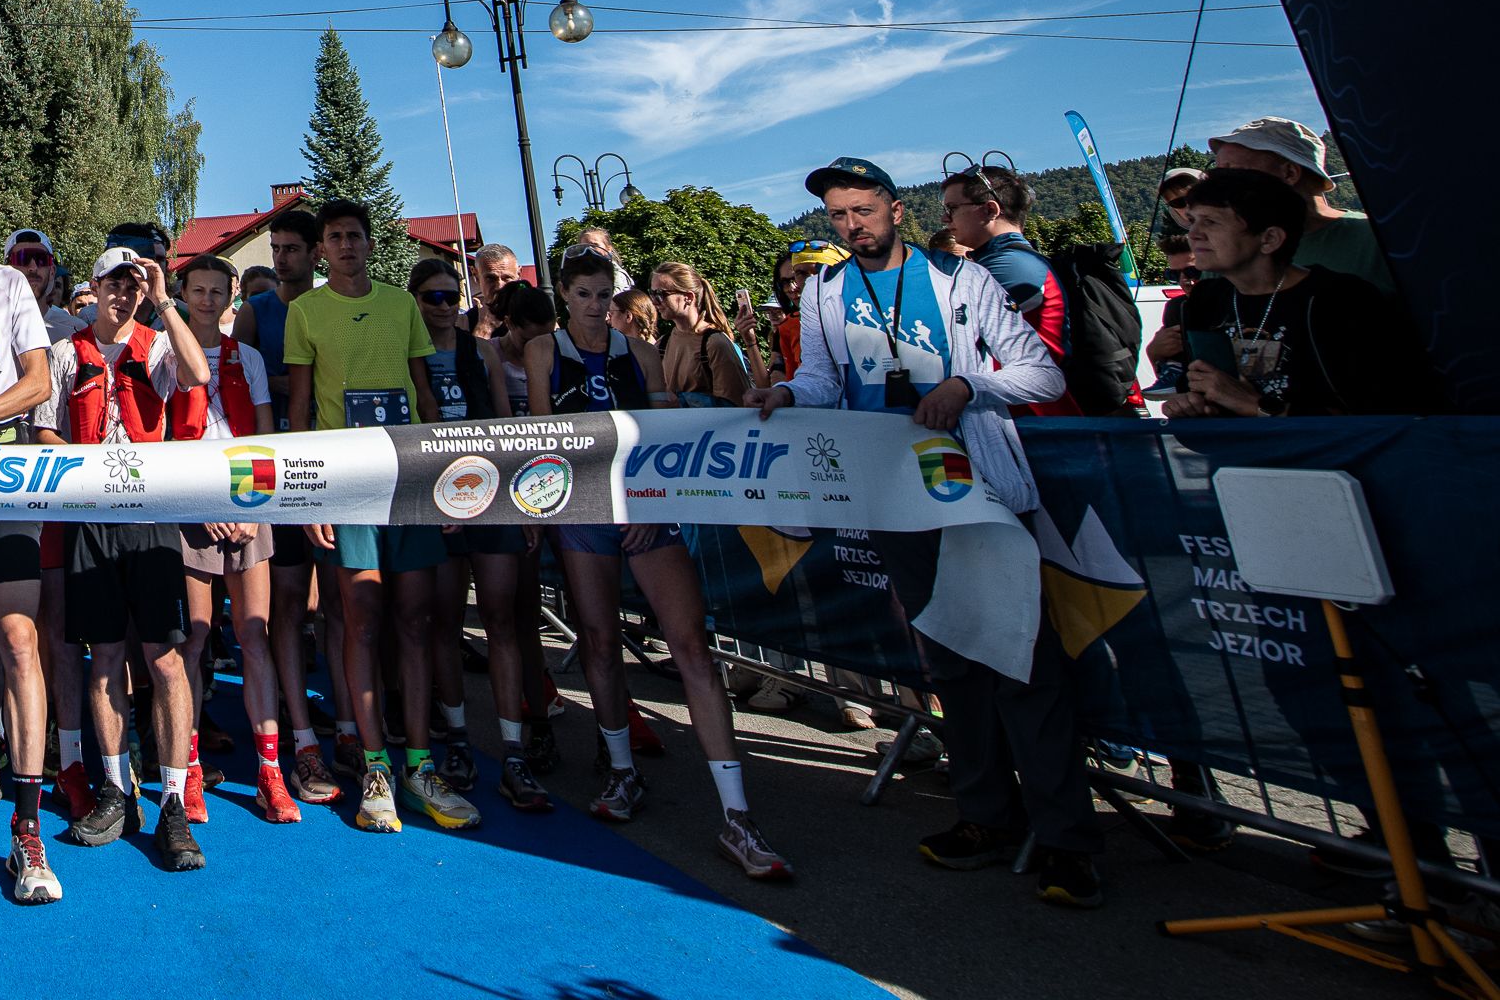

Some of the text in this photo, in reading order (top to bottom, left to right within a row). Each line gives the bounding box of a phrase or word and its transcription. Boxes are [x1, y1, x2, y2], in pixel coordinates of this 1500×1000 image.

[441, 385, 462, 400] 10
[375, 406, 386, 422] 9
[432, 421, 574, 438] WMRA MOUNTAIN
[420, 436, 595, 453] RUNNING WORLD CUP
[625, 430, 789, 479] valsir
[283, 458, 324, 468] Turismo
[284, 470, 318, 480] Centro
[810, 472, 846, 483] SILMAR
[104, 484, 146, 493] SILMAR
[283, 481, 327, 491] Portugal
[626, 488, 666, 498] fondital
[685, 489, 733, 497] RAFFMETAL
[745, 489, 765, 500] OLI
[778, 491, 811, 500] MARVON
[27, 501, 49, 509] OLI
[843, 570, 889, 590] JEZIOR
[1193, 566, 1252, 592] MAR
[1191, 598, 1307, 632] TRZECH
[1208, 630, 1306, 667] JEZIOR
